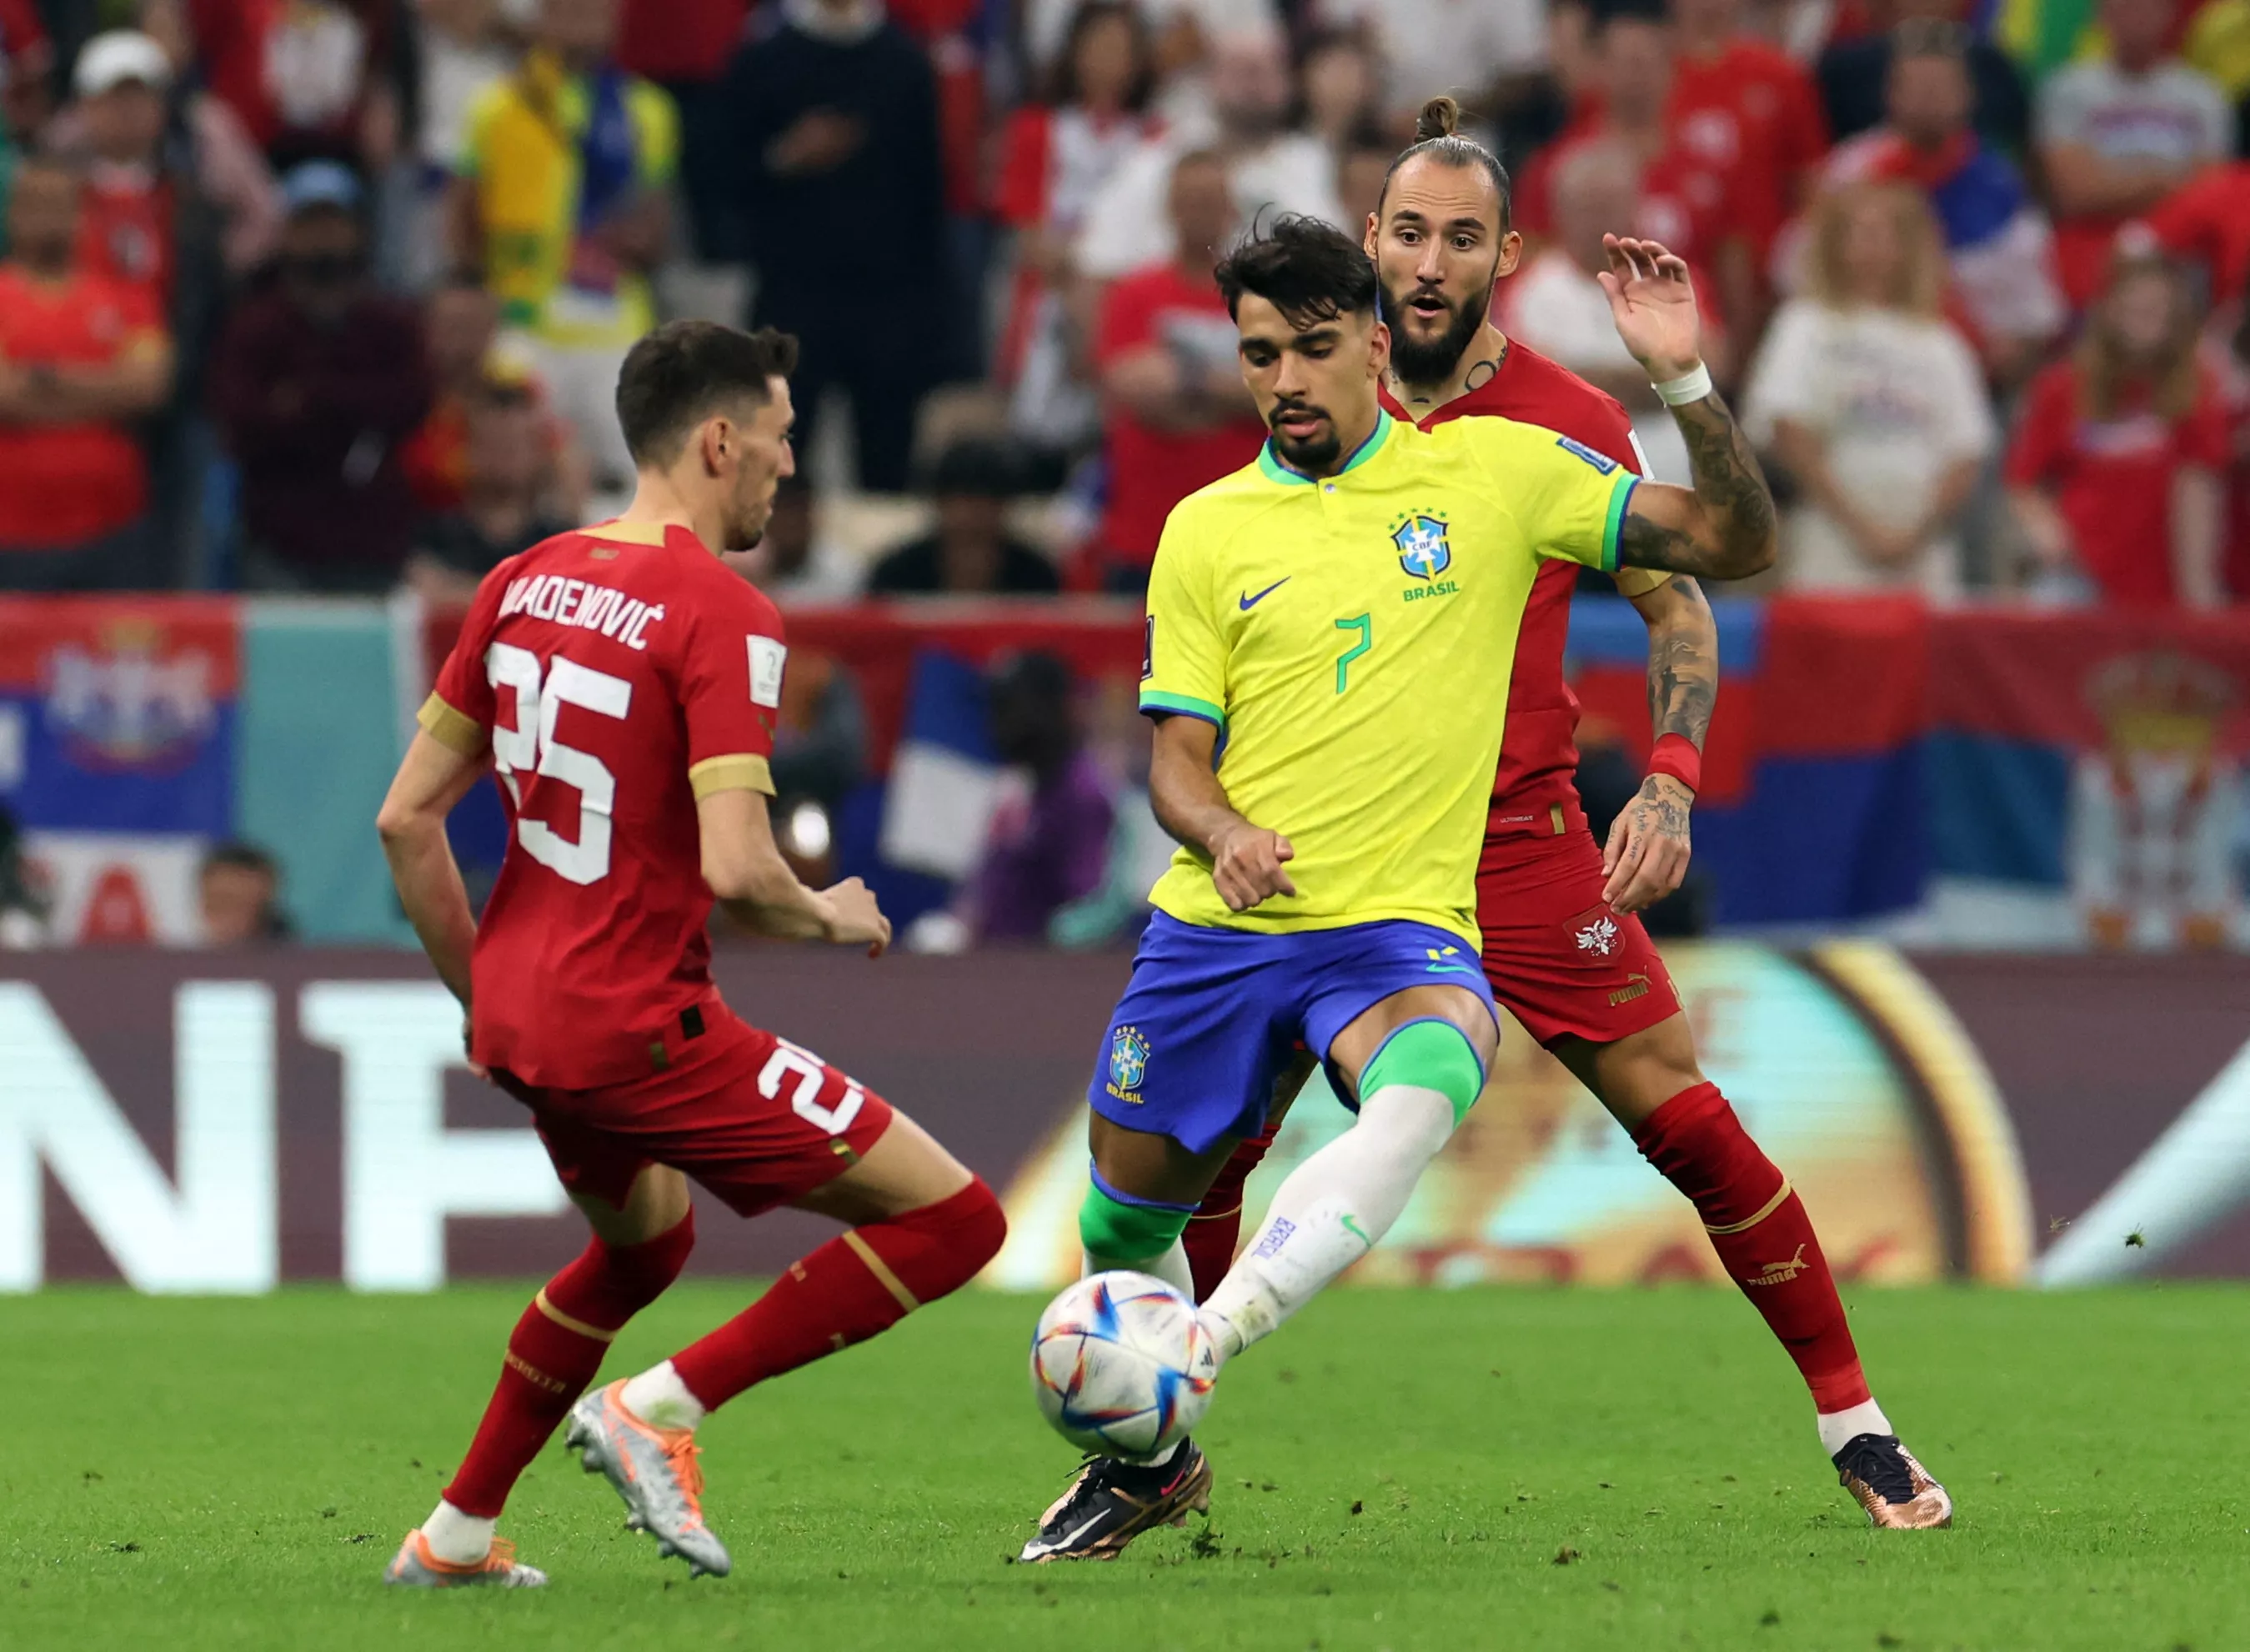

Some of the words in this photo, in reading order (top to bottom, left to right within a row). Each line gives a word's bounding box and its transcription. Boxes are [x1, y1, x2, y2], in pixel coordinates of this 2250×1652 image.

[1403, 580, 1460, 602] BRASIL
[1335, 612, 1371, 695] 7
[1106, 1082, 1145, 1104] BRASIL
